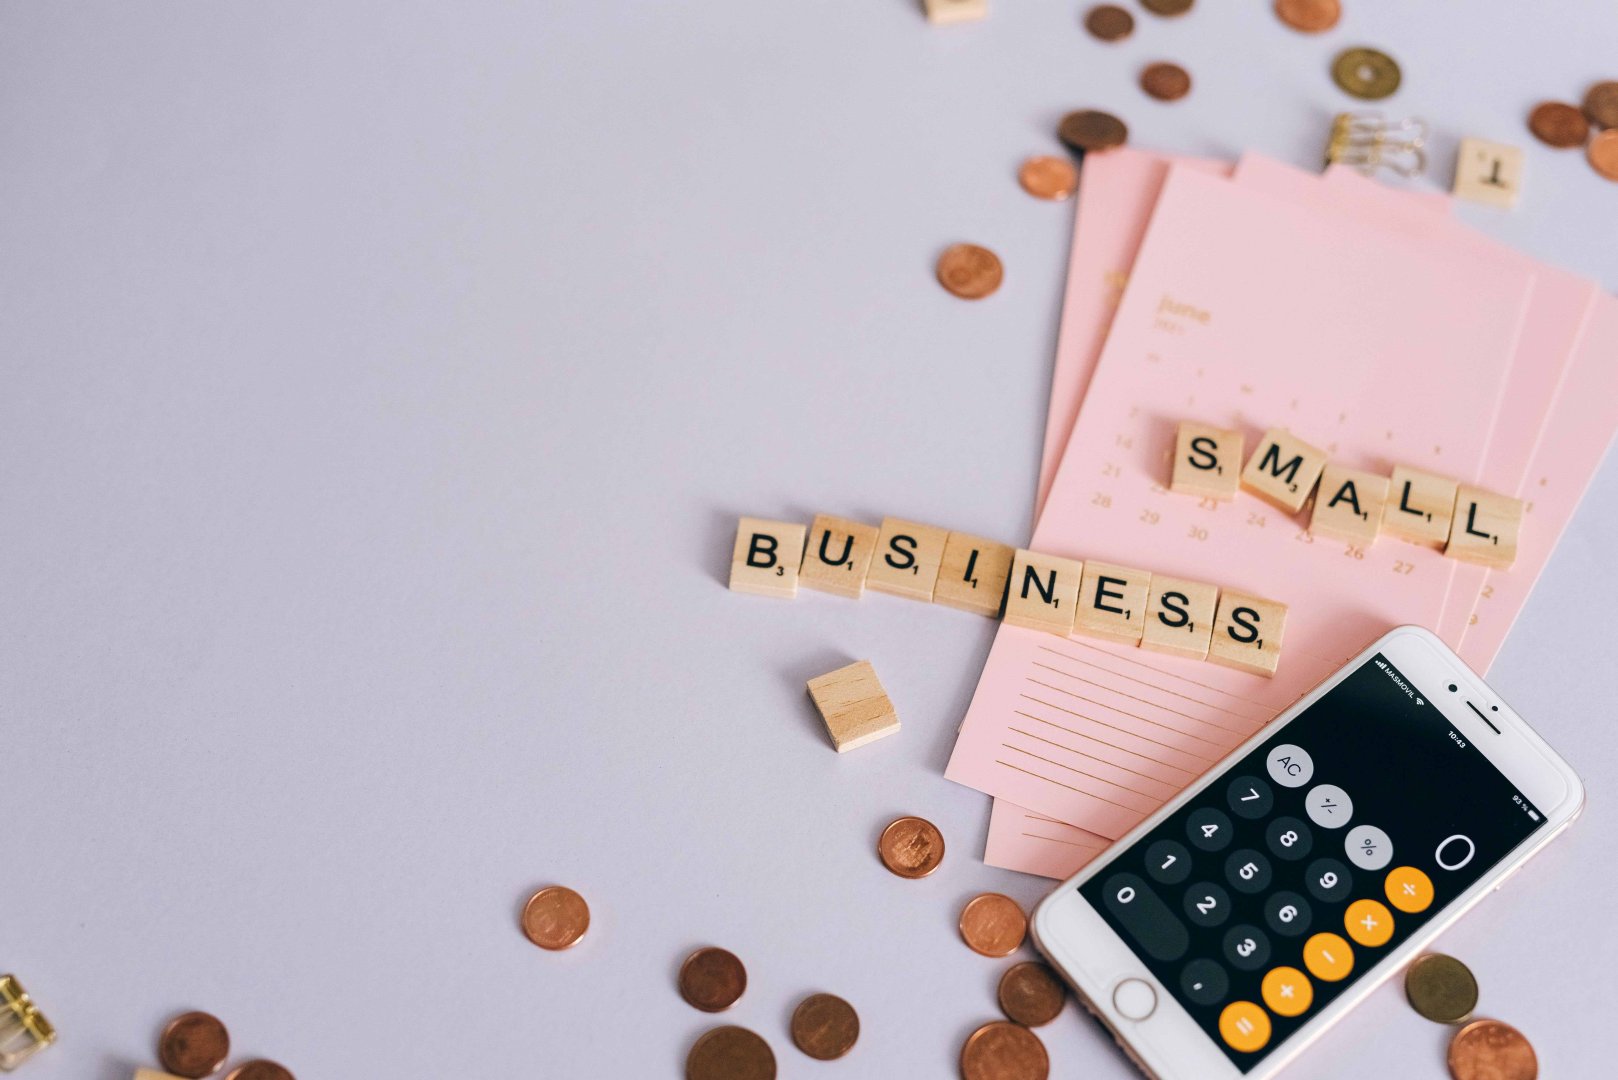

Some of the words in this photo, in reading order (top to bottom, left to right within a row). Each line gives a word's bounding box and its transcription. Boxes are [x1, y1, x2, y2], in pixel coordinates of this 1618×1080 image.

[1187, 437, 1490, 540] SMALL
[746, 529, 1260, 644] BUSINESS
[1392, 560, 1416, 576] 27
[1384, 667, 1415, 699] MASMOVIL
[1447, 730, 1466, 750] 10:43
[1240, 788, 1261, 802] 7
[1279, 830, 1299, 848] 8
[1319, 871, 1338, 889] 9
[1277, 756, 1302, 777] AC
[1360, 838, 1377, 856] %
[1116, 886, 1136, 904] 0
[1161, 854, 1177, 870] 1
[1196, 895, 1218, 915] 2
[1236, 938, 1257, 957] 3
[1200, 824, 1219, 838] 4
[1239, 862, 1259, 880] 5
[1278, 904, 1298, 923] 6
